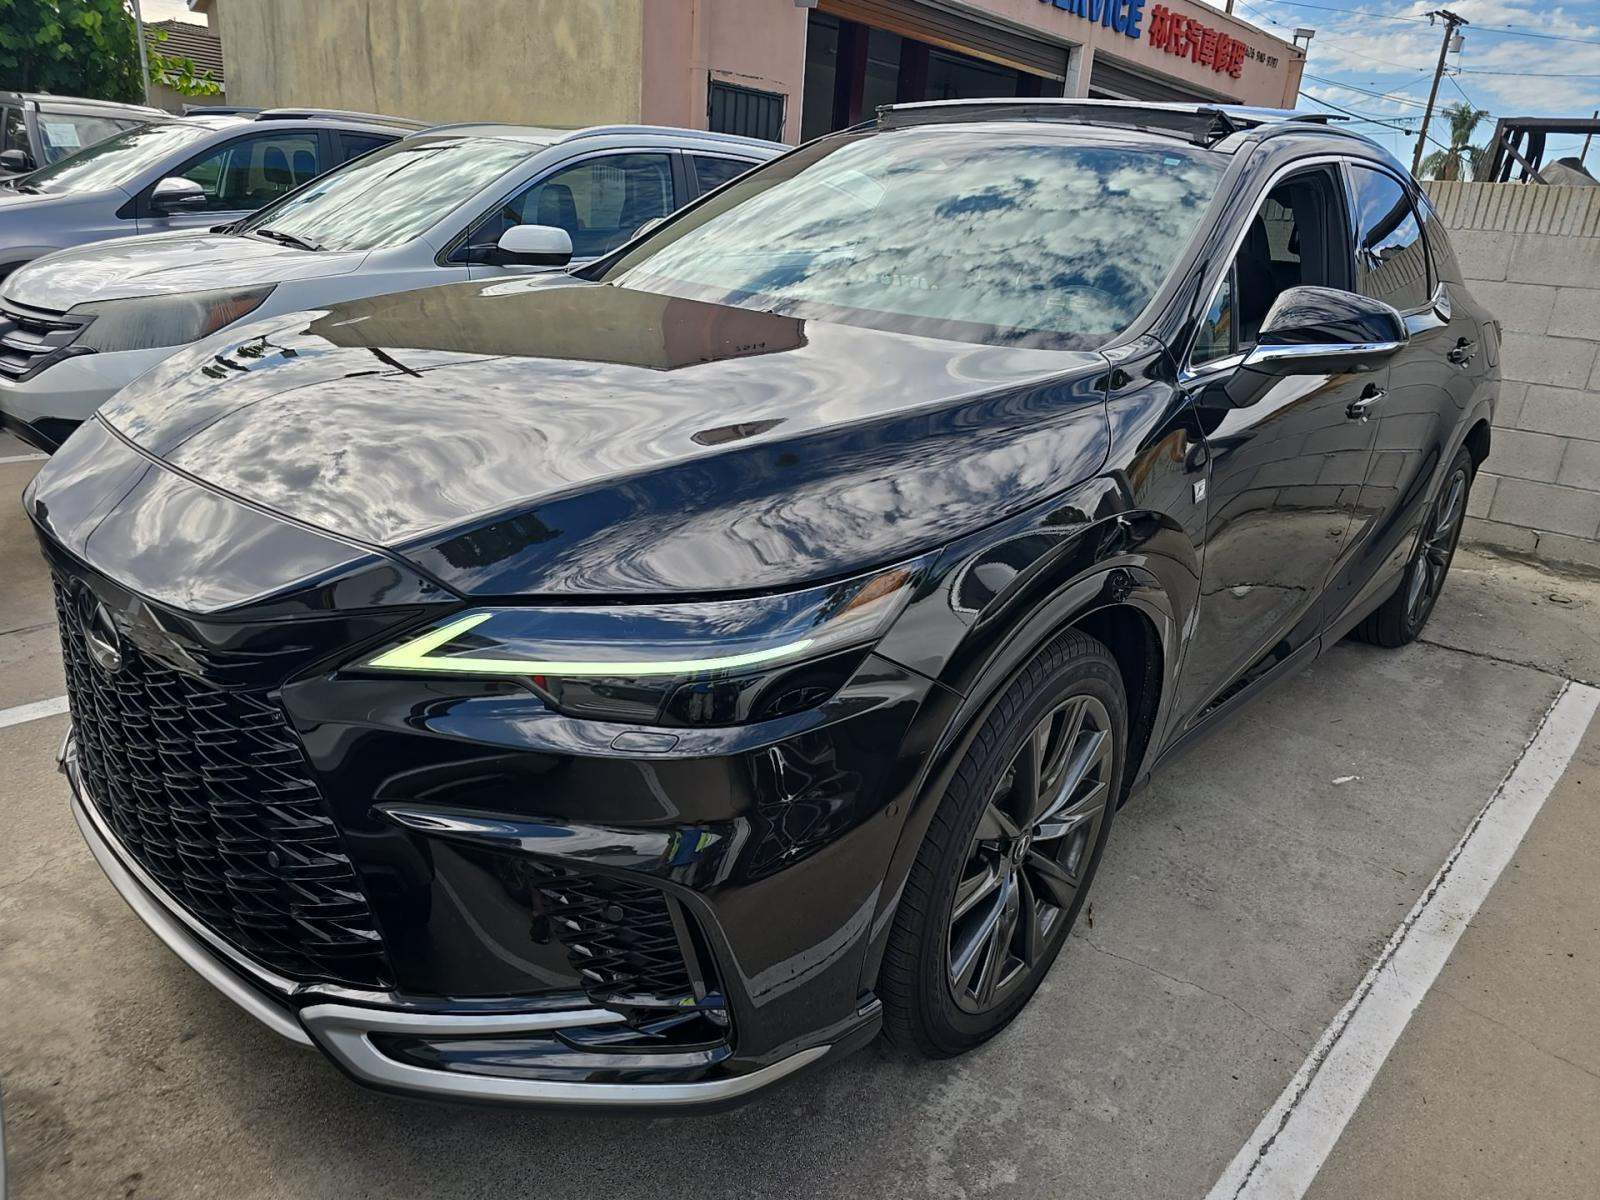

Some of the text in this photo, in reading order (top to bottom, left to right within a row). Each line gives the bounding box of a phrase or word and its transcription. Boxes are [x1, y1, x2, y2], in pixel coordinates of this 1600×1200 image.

[1148, 4, 1247, 78] 林氏汽車修理
